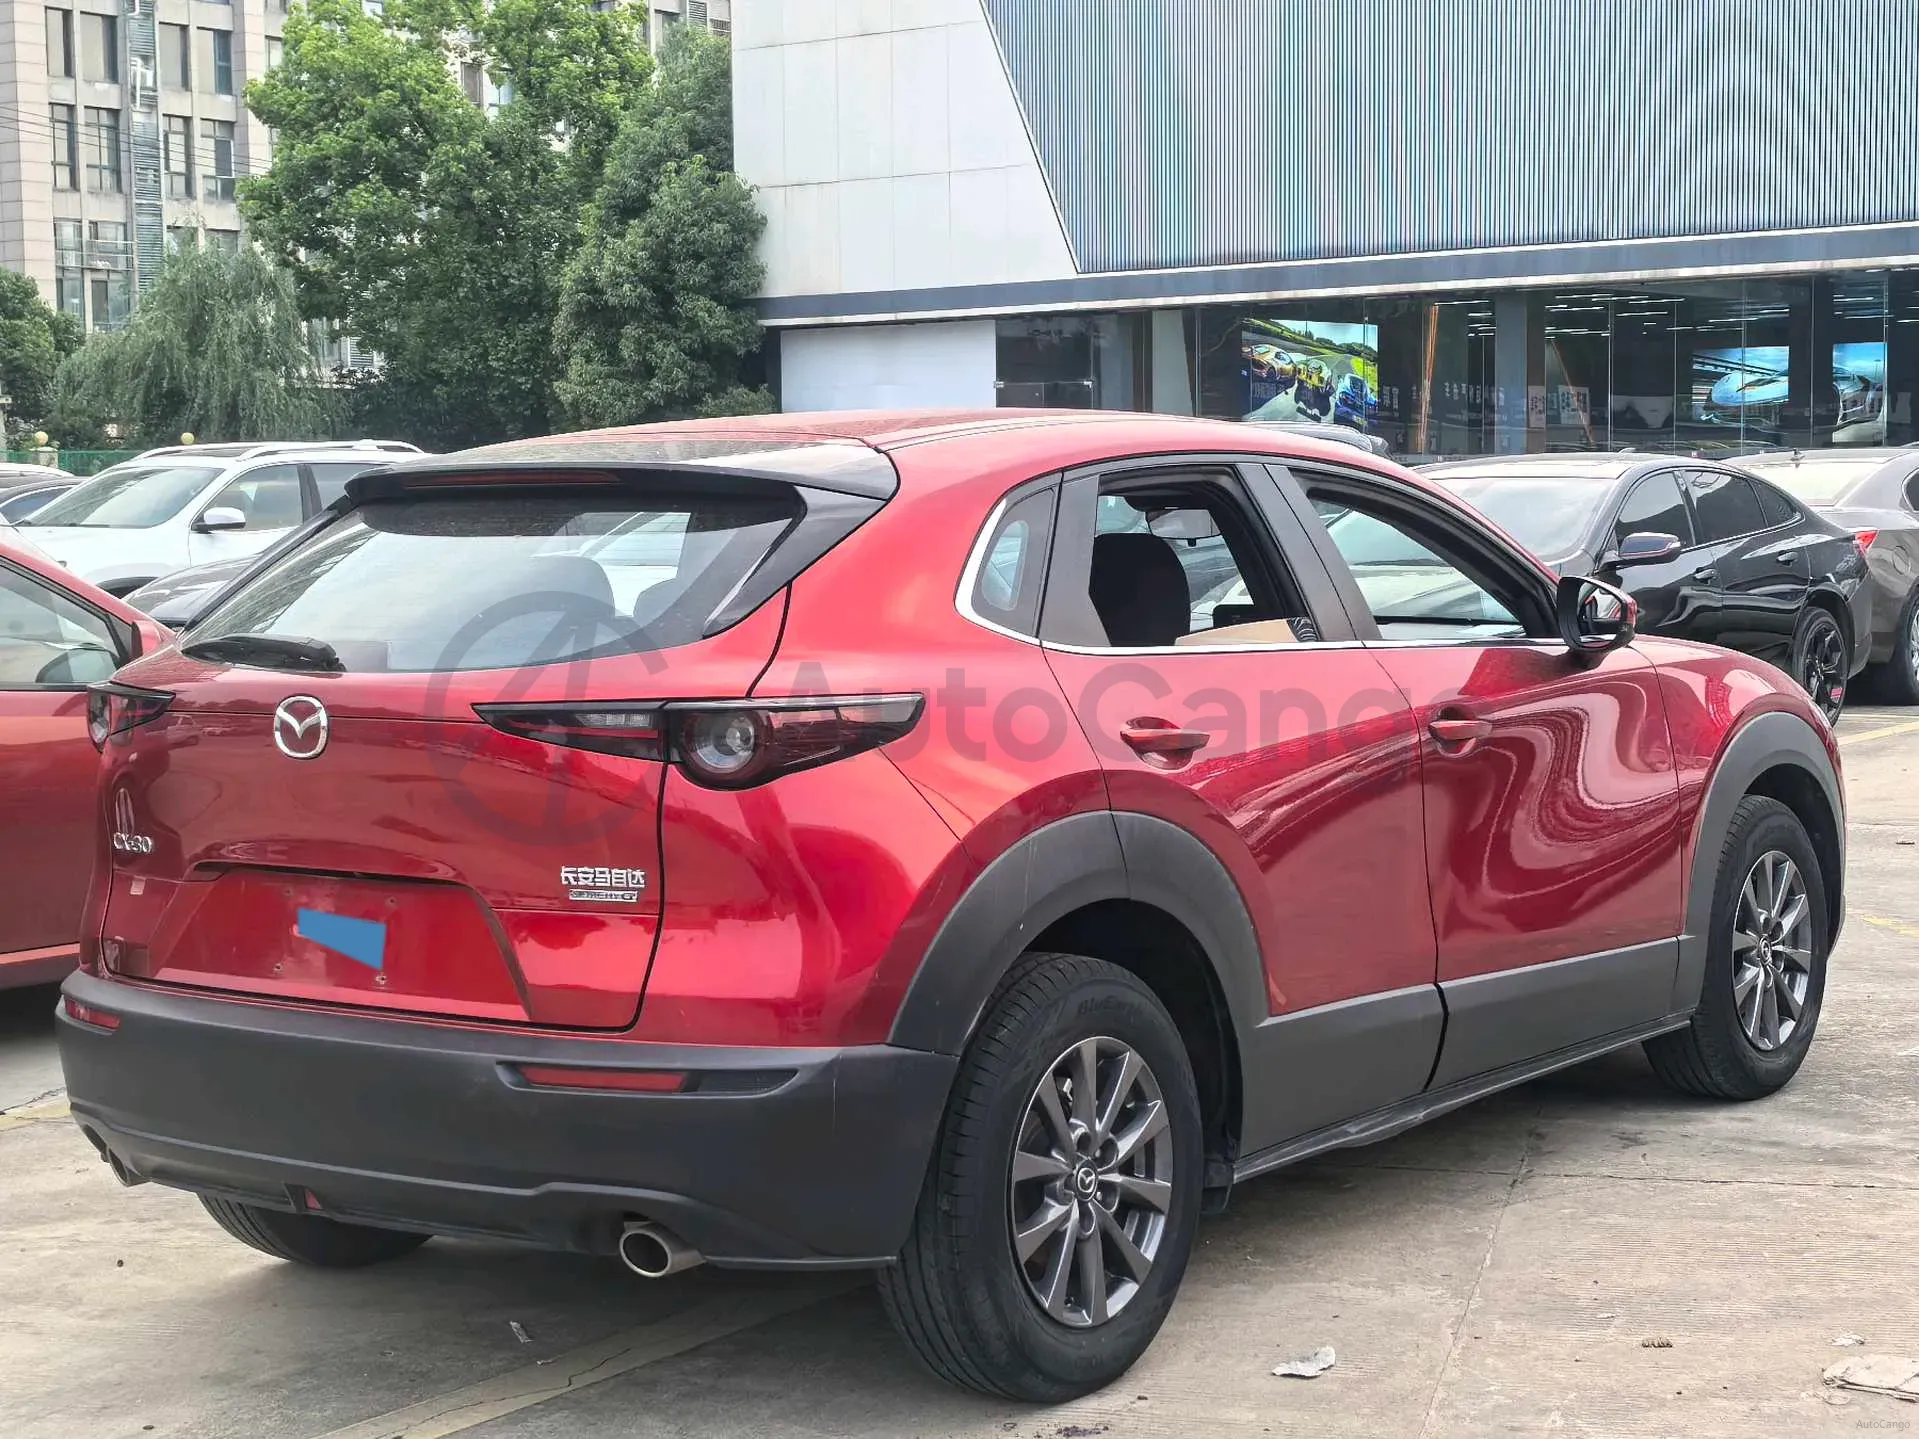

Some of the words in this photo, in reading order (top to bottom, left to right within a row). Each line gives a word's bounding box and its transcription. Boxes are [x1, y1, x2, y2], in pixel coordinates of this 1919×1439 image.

[560, 865, 646, 888] 长安马自达
